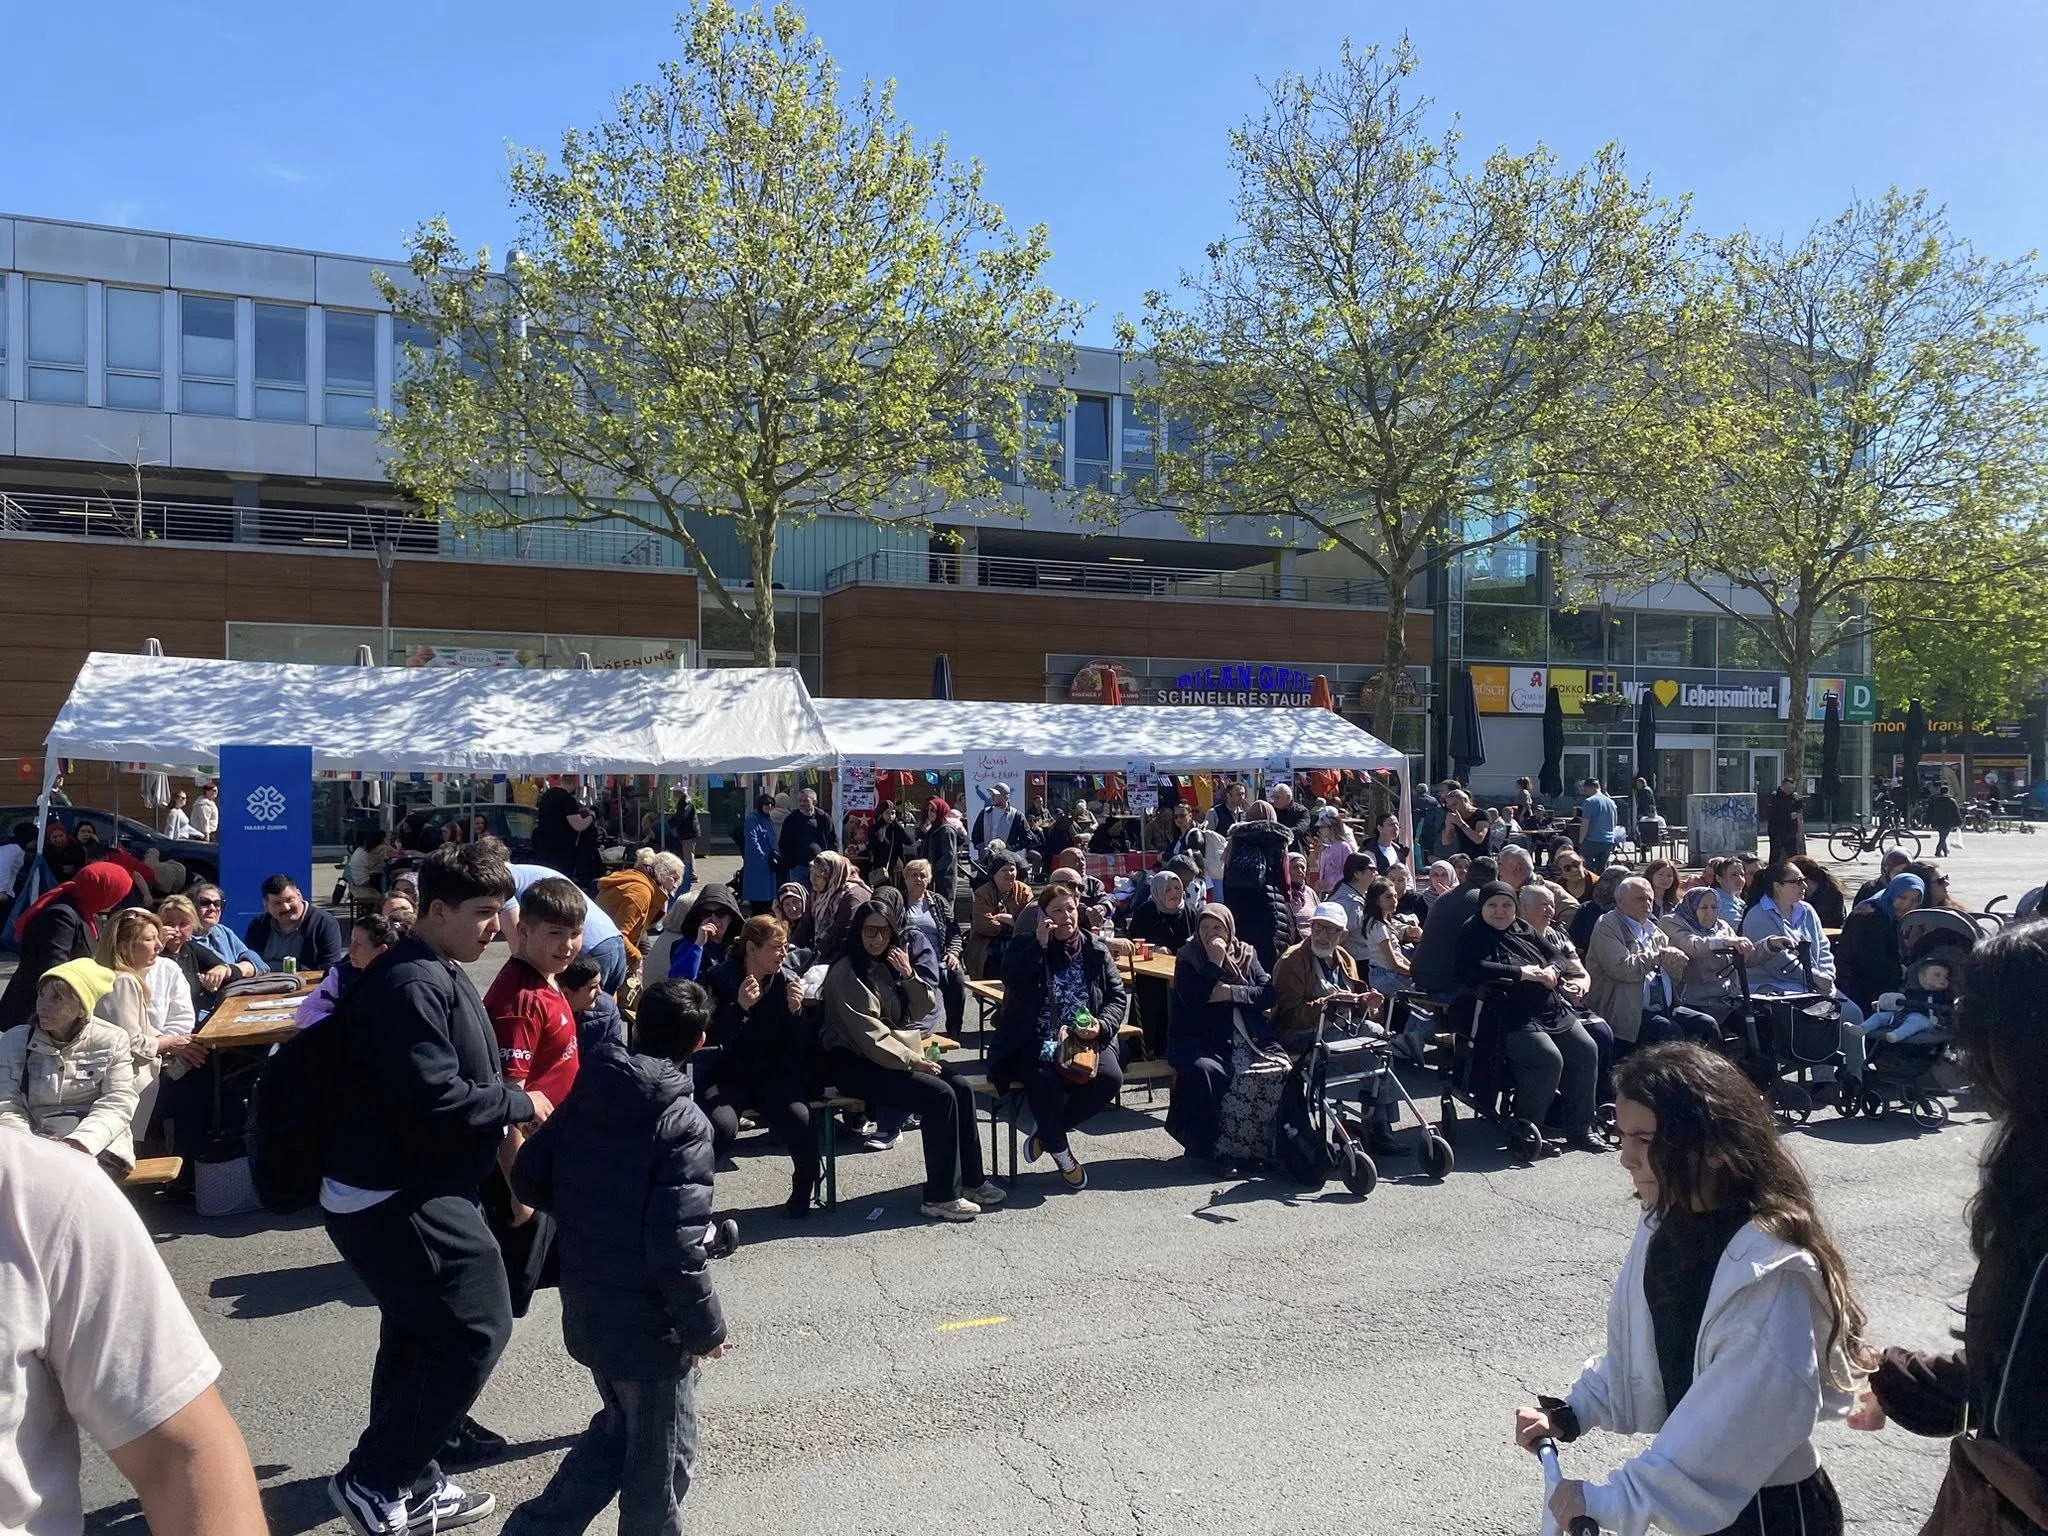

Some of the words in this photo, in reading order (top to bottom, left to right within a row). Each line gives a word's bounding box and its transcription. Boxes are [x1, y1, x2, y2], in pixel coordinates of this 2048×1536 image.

[460, 655, 492, 663] ROMA
[595, 650, 675, 669] ÖFFNUNG
[1553, 685, 1584, 694] AKKO
[1854, 685, 1870, 708] D
[1157, 690, 1345, 707] SCHNELLRESTAURT
